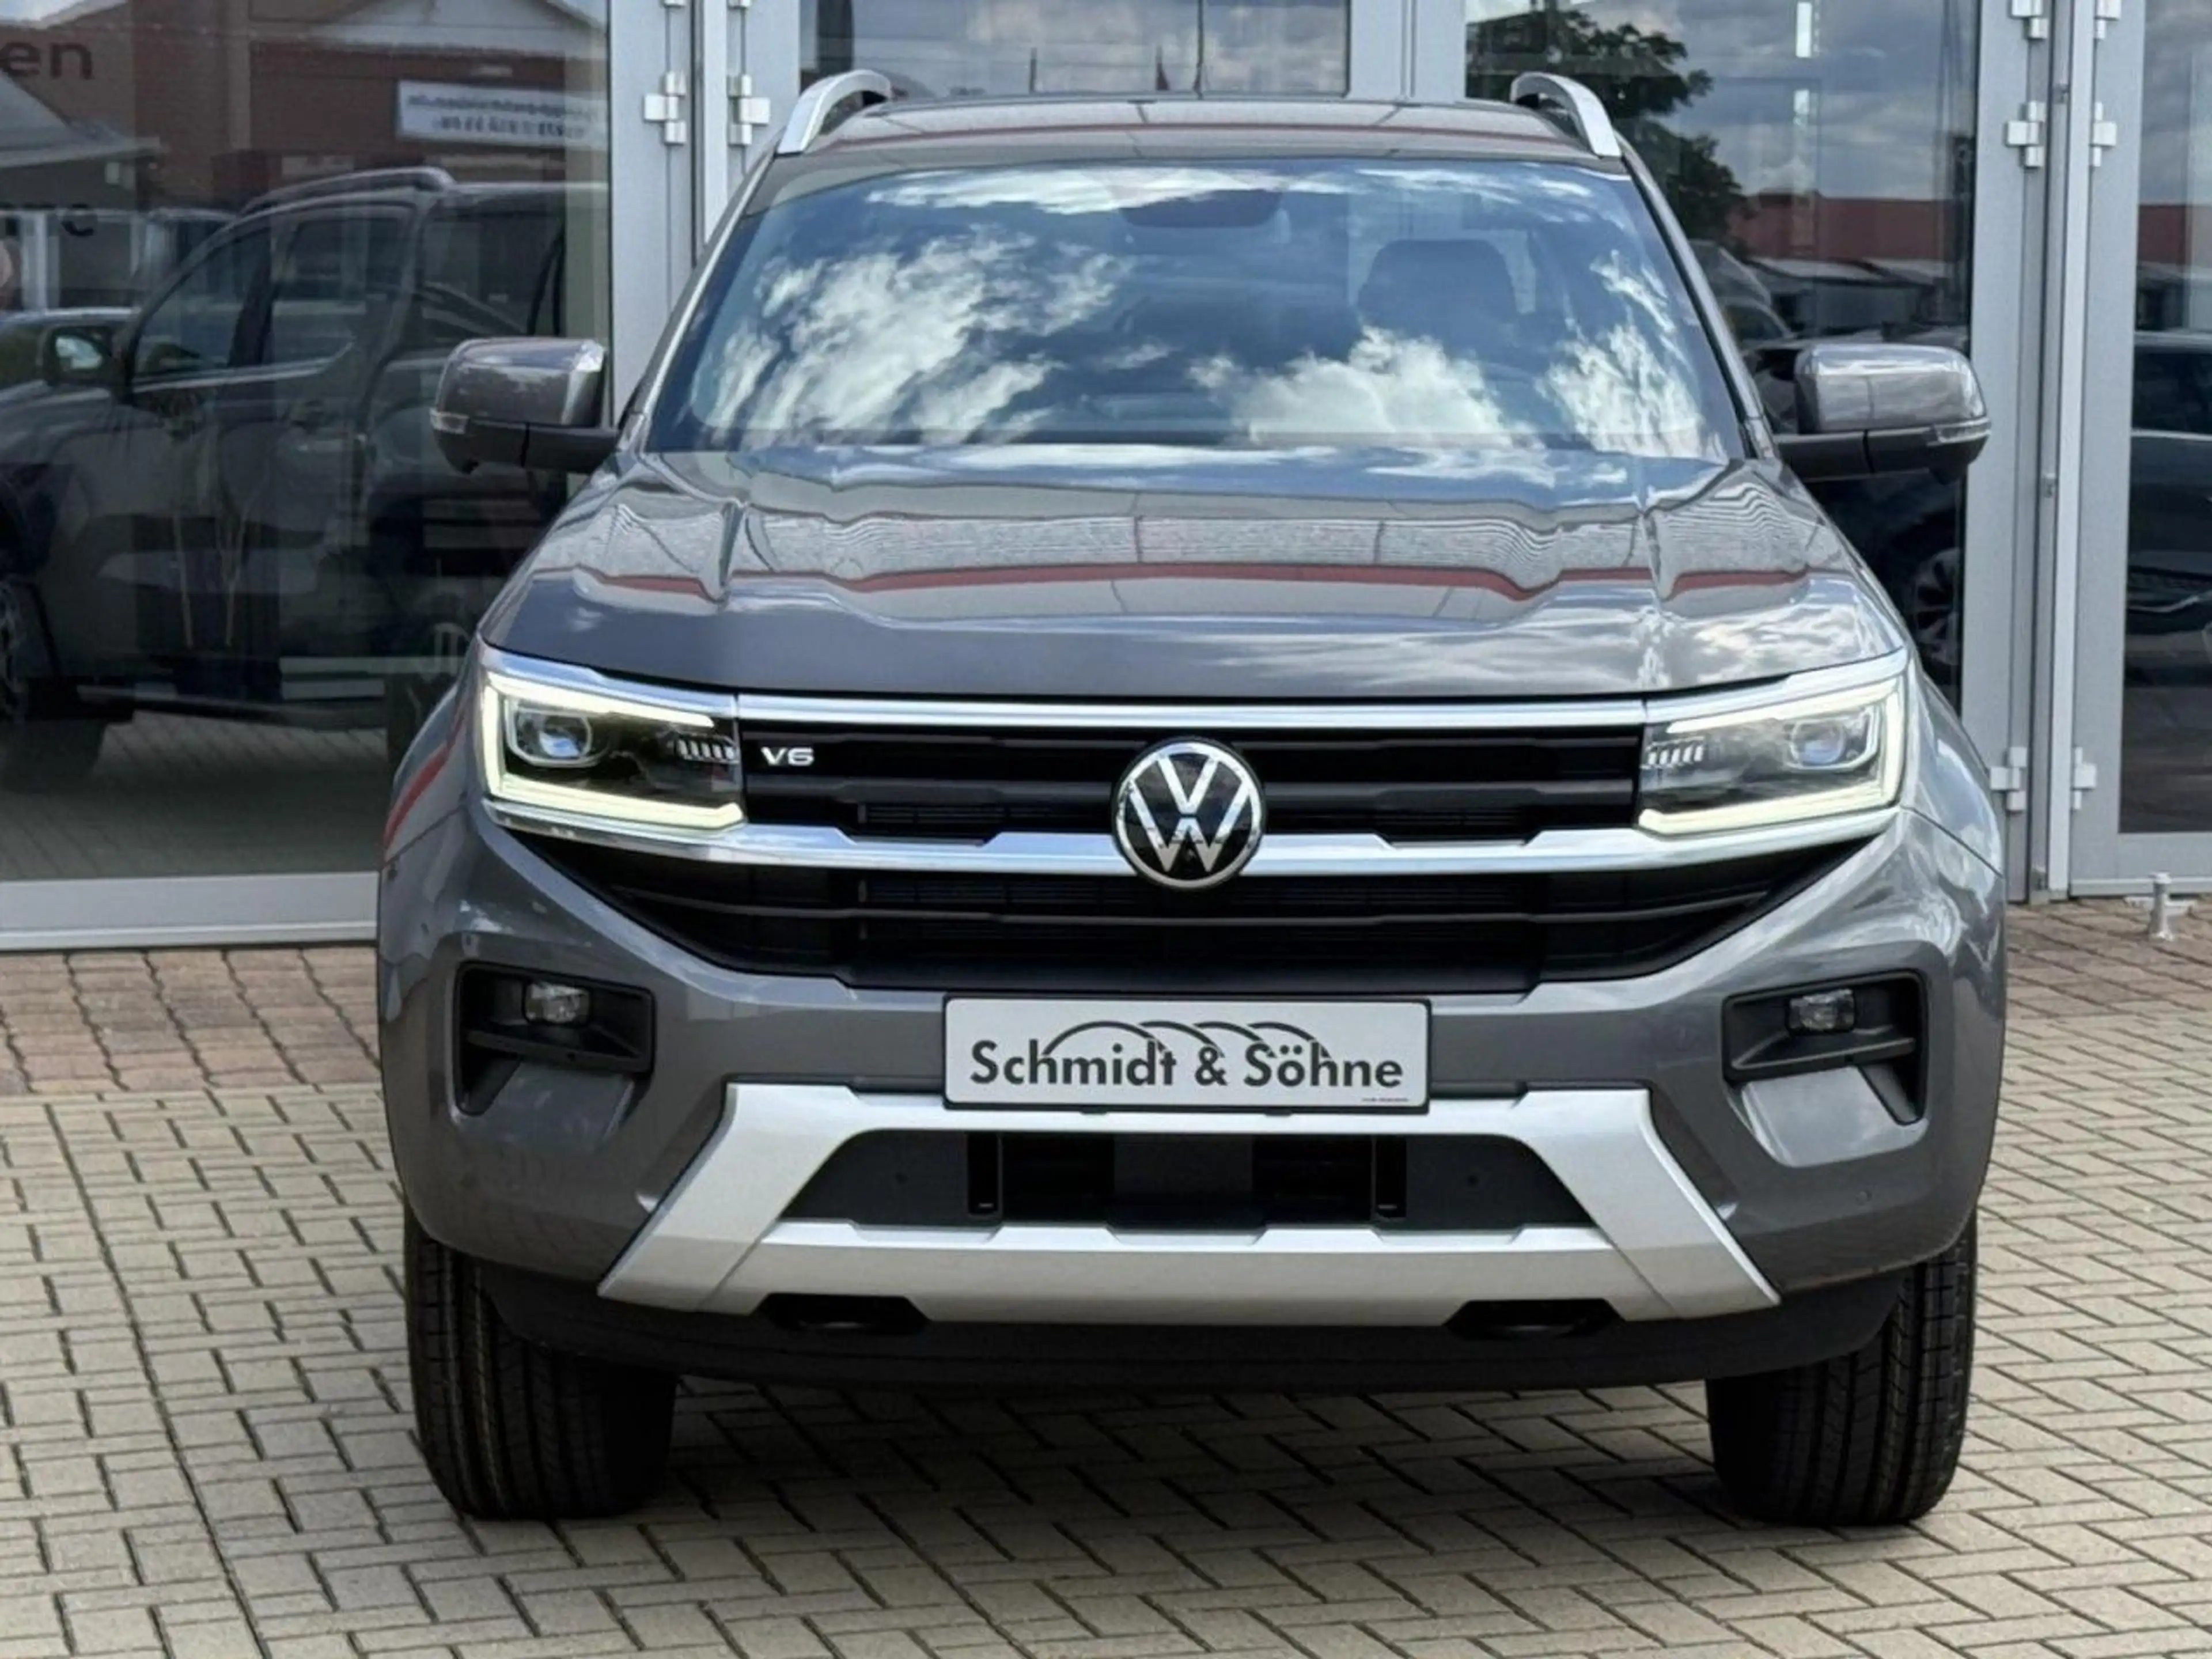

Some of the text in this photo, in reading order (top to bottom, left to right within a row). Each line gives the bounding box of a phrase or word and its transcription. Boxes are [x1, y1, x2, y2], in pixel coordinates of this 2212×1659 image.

[760, 747, 814, 767] V6
[1125, 749, 1252, 873] VW
[970, 1039, 1403, 1088] Schmidt & Söhne
